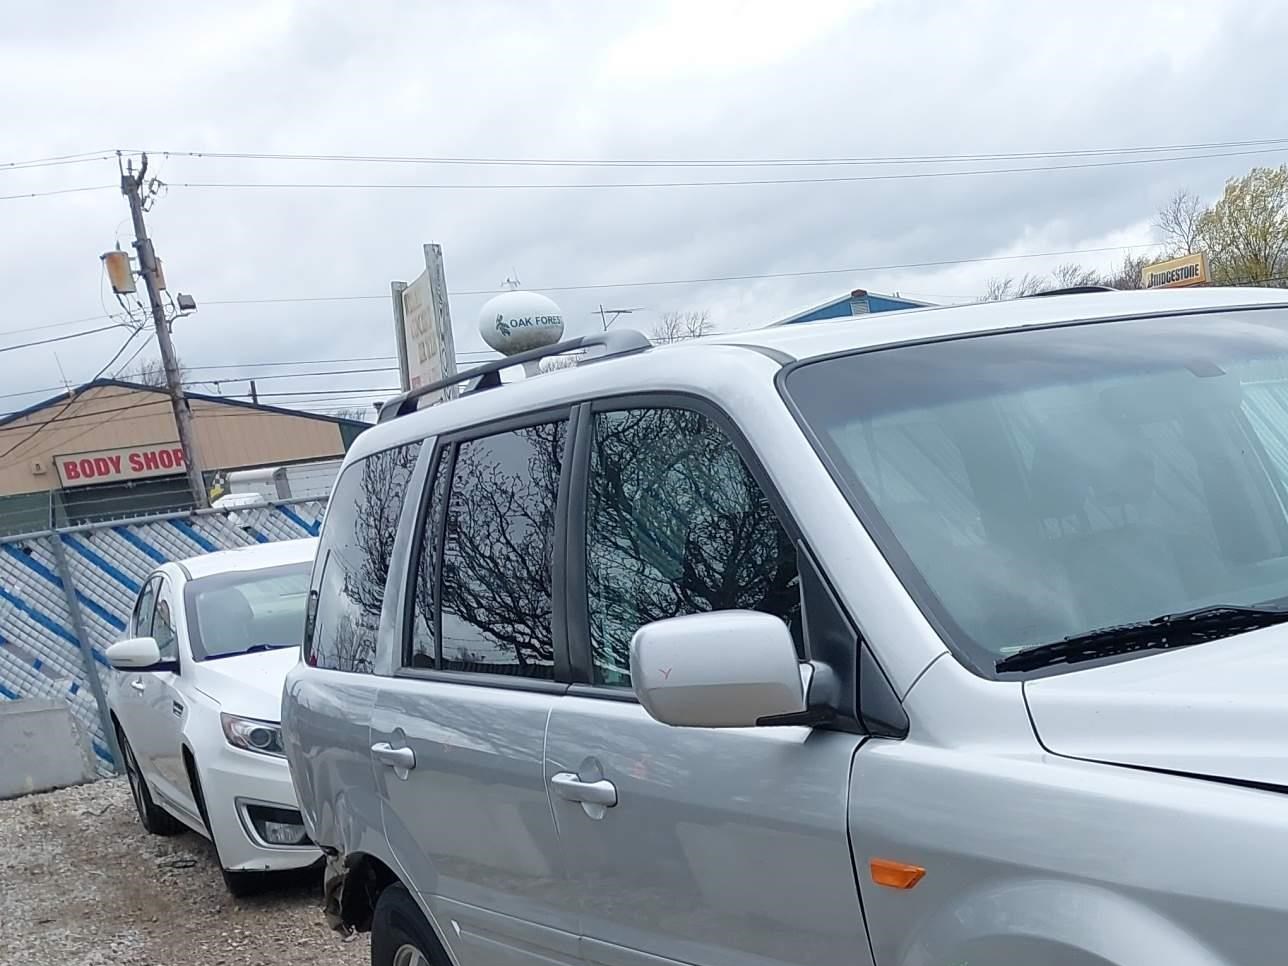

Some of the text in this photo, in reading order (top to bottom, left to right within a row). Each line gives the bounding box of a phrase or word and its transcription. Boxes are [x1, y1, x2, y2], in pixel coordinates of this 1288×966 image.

[510, 315, 562, 328] OAK FORES
[63, 448, 185, 480] BODY SHOP
